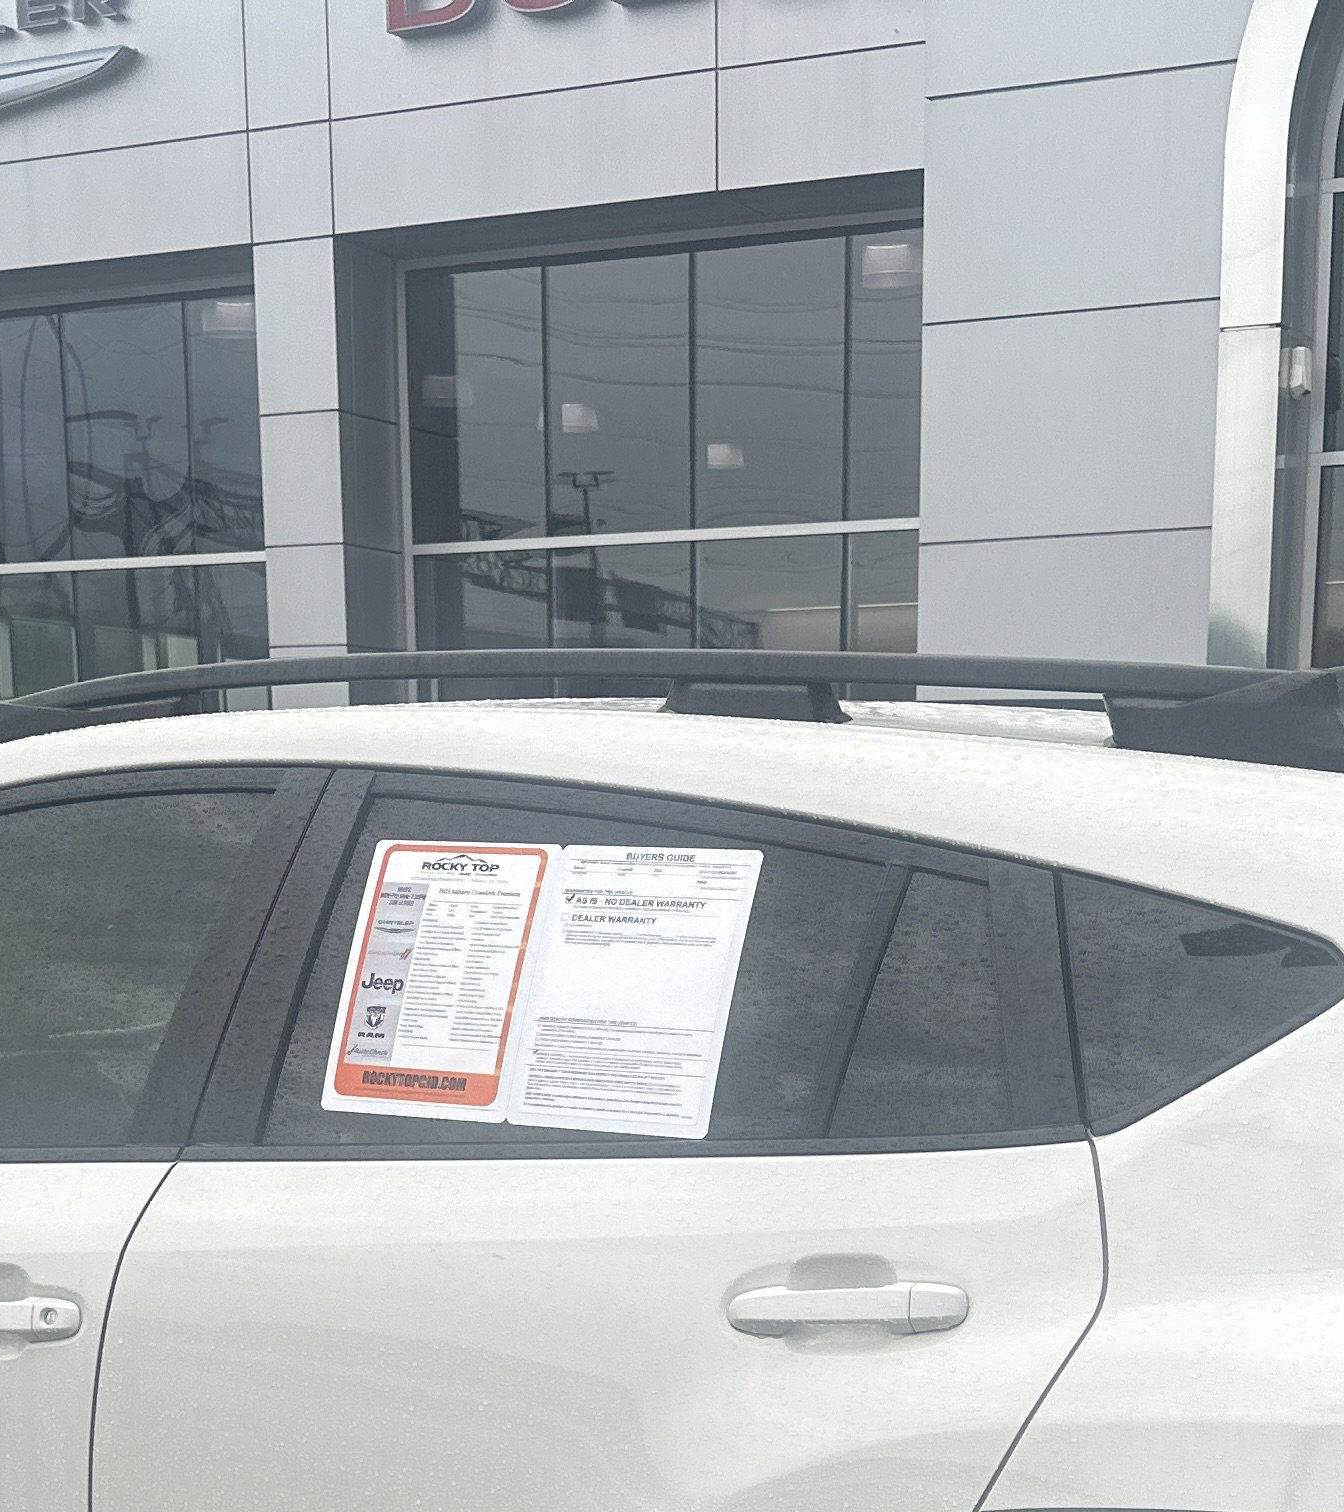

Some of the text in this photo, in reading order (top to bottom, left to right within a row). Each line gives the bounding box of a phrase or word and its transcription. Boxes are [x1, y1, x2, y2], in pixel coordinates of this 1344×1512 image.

[666, 854, 696, 863] GUIDE
[421, 861, 499, 873] ROCKY TOP
[575, 897, 588, 905] AS
[605, 898, 617, 906] NO
[619, 899, 654, 907] DEALER
[656, 900, 706, 909] WARRANTY
[571, 914, 656, 925] DEALER WARRANTY
[361, 972, 404, 994] Jeep
[357, 1031, 385, 1039] RAM
